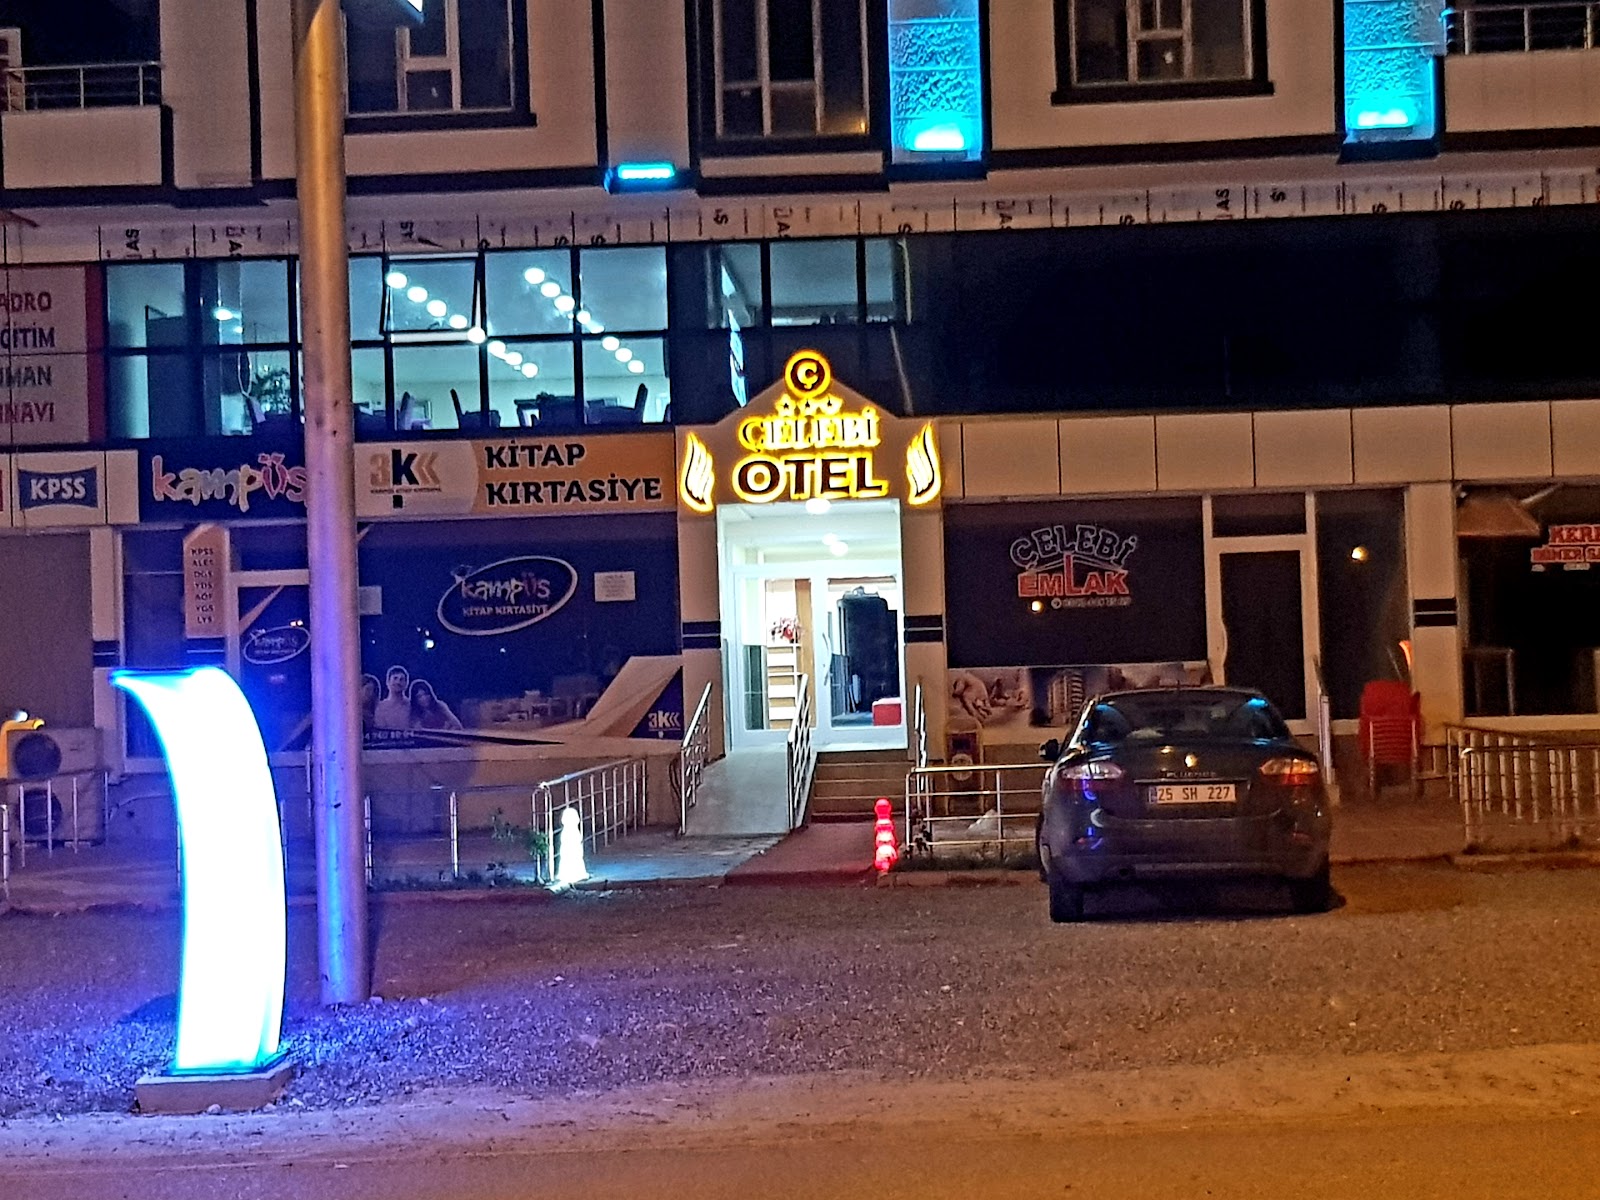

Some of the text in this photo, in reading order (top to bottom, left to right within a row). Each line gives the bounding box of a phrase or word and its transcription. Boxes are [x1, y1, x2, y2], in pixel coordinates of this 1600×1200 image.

[485, 440, 586, 470] KİTAP
[30, 477, 86, 500] KPSS
[486, 473, 662, 505] KIRTASİYE
[733, 453, 887, 502] OTEL
[461, 572, 551, 604] kampüs
[1018, 552, 1130, 597] EMLAK
[463, 604, 493, 616] KİTAP
[1158, 786, 1230, 800] 25 SH 227
